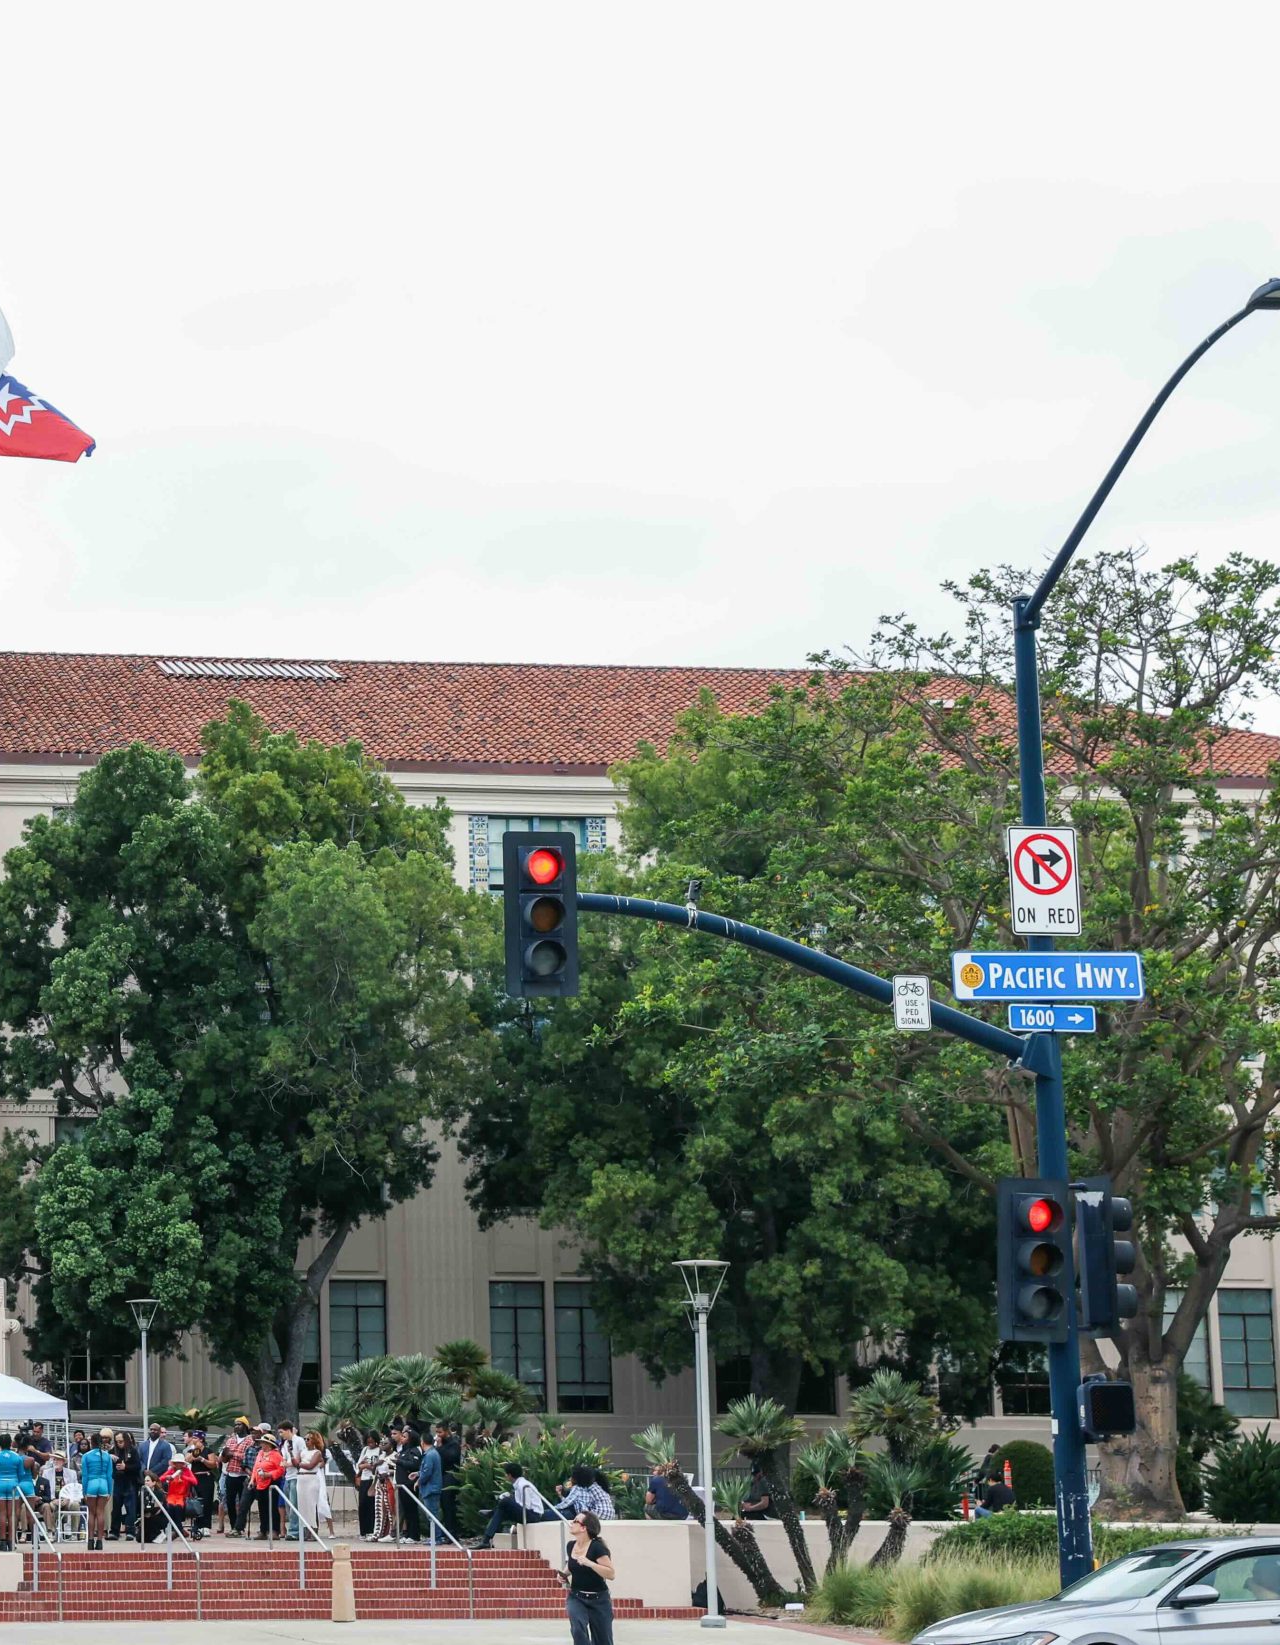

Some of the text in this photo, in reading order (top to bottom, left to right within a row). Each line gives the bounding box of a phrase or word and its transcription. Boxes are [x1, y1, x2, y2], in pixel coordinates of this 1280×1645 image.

[1017, 907, 1075, 924] ON RED
[1020, 1009, 1055, 1026] 1600
